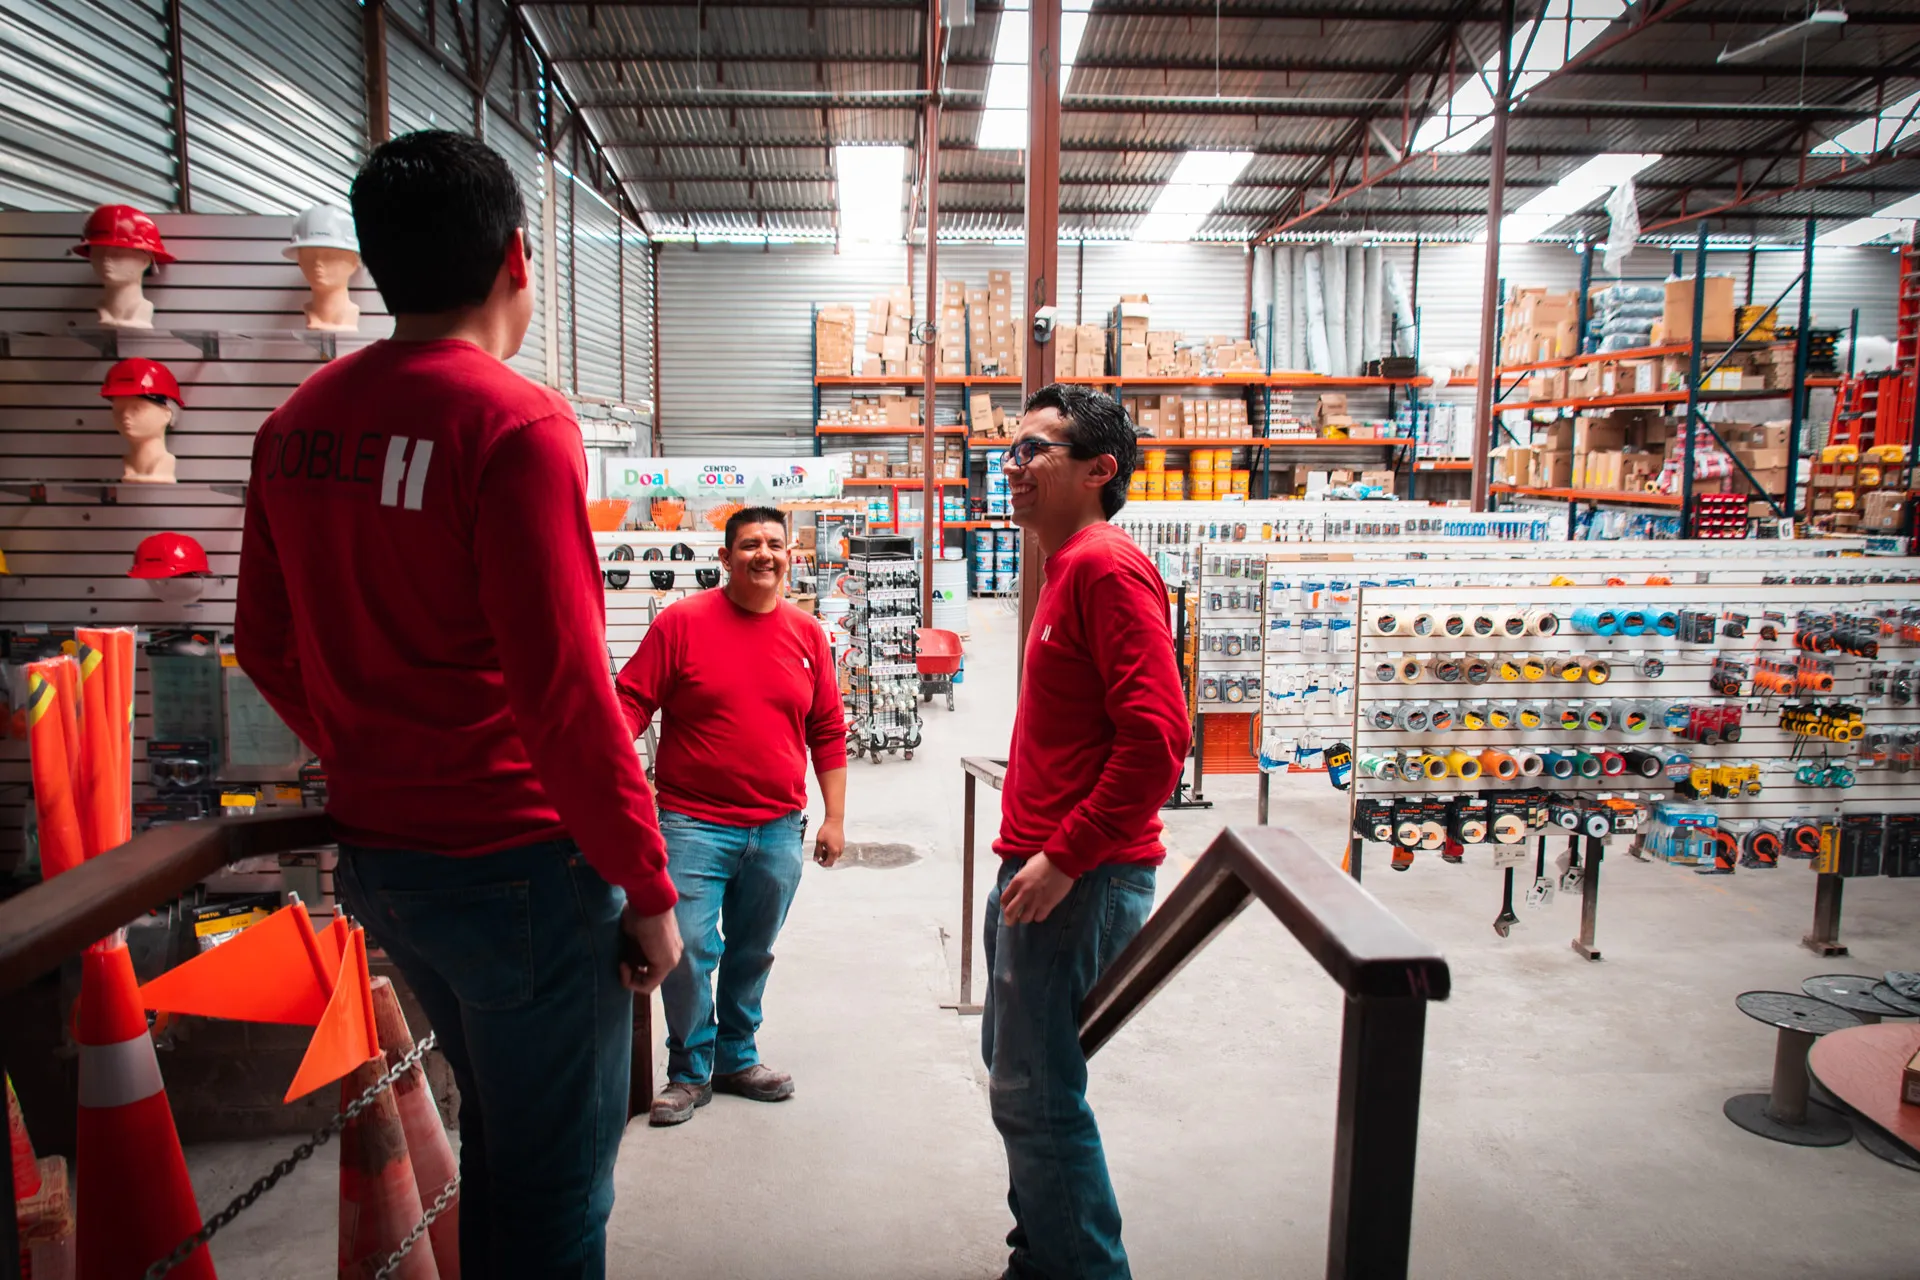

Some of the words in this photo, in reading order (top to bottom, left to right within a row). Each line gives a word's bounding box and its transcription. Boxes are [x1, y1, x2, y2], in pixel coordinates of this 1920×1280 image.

[703, 465, 737, 473] CENTRO
[624, 467, 669, 486] Doal
[697, 473, 744, 485] COLOR
[775, 474, 800, 486] 1320
